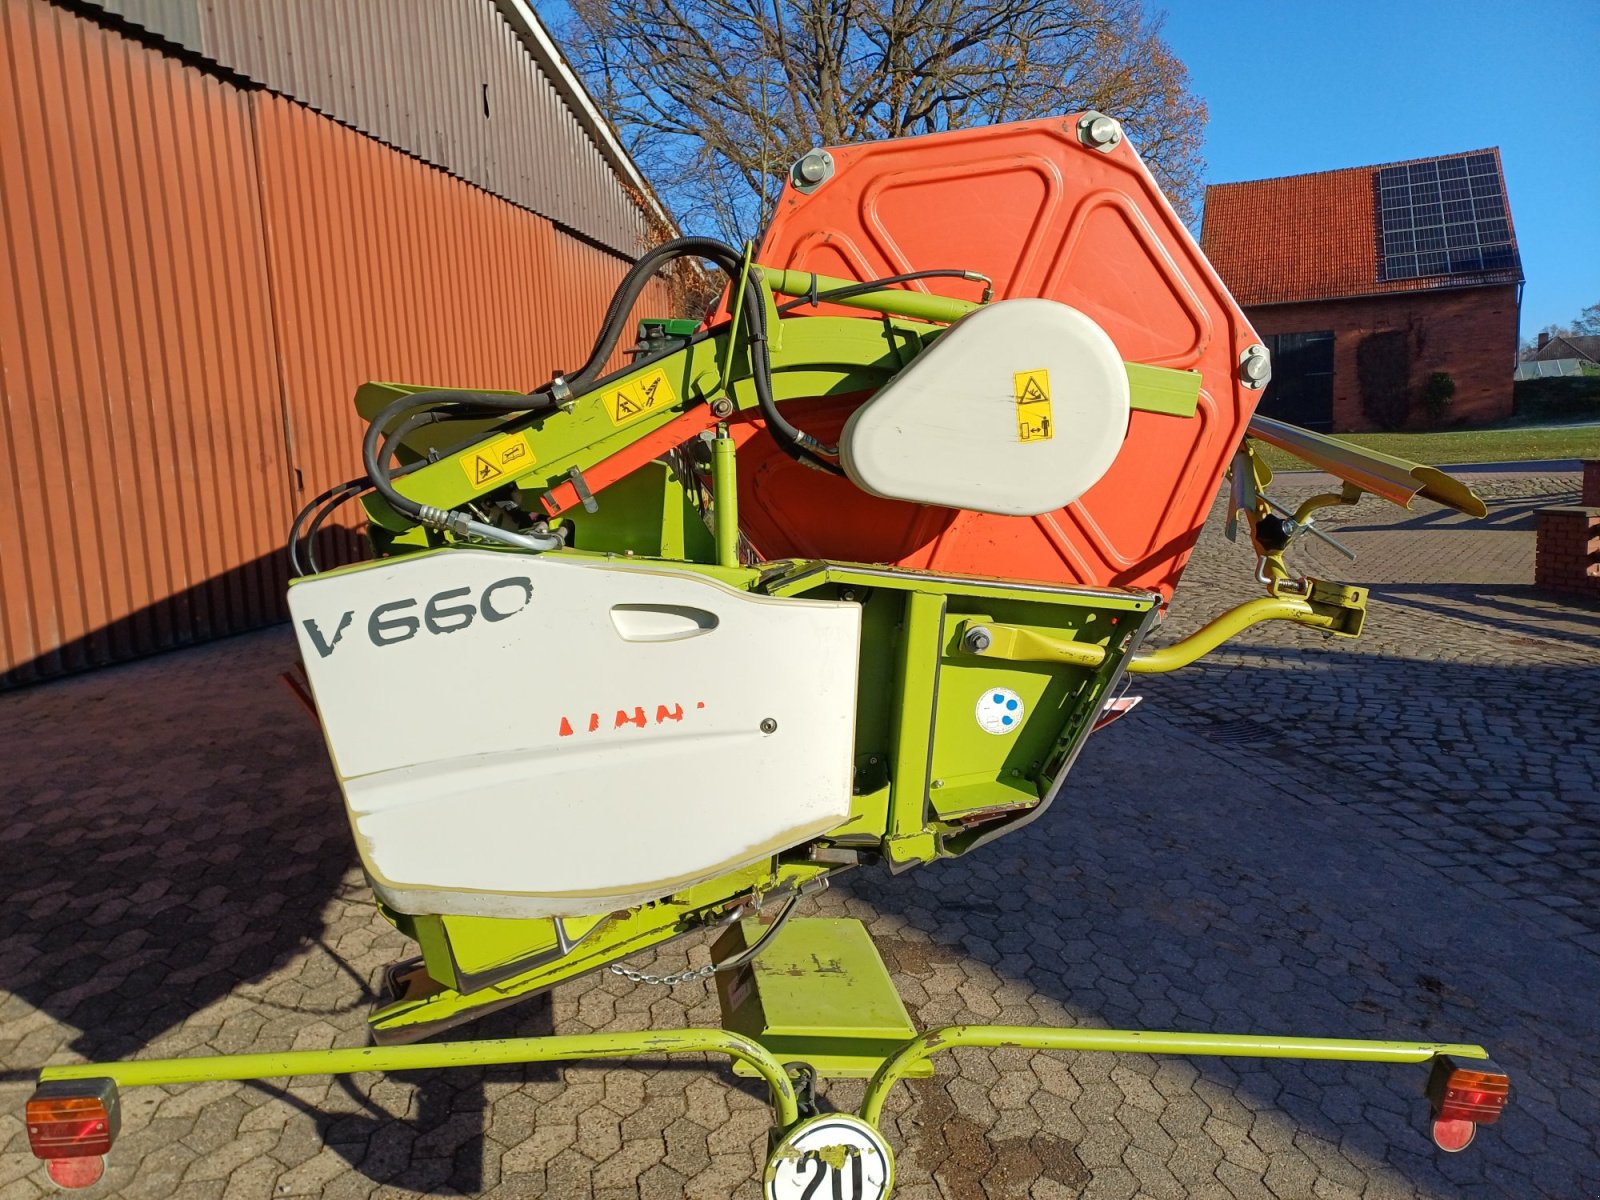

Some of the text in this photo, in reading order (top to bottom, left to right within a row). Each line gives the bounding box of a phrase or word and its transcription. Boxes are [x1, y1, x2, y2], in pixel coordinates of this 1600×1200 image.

[303, 576, 534, 658] V 660
[796, 1144, 863, 1200] 20
